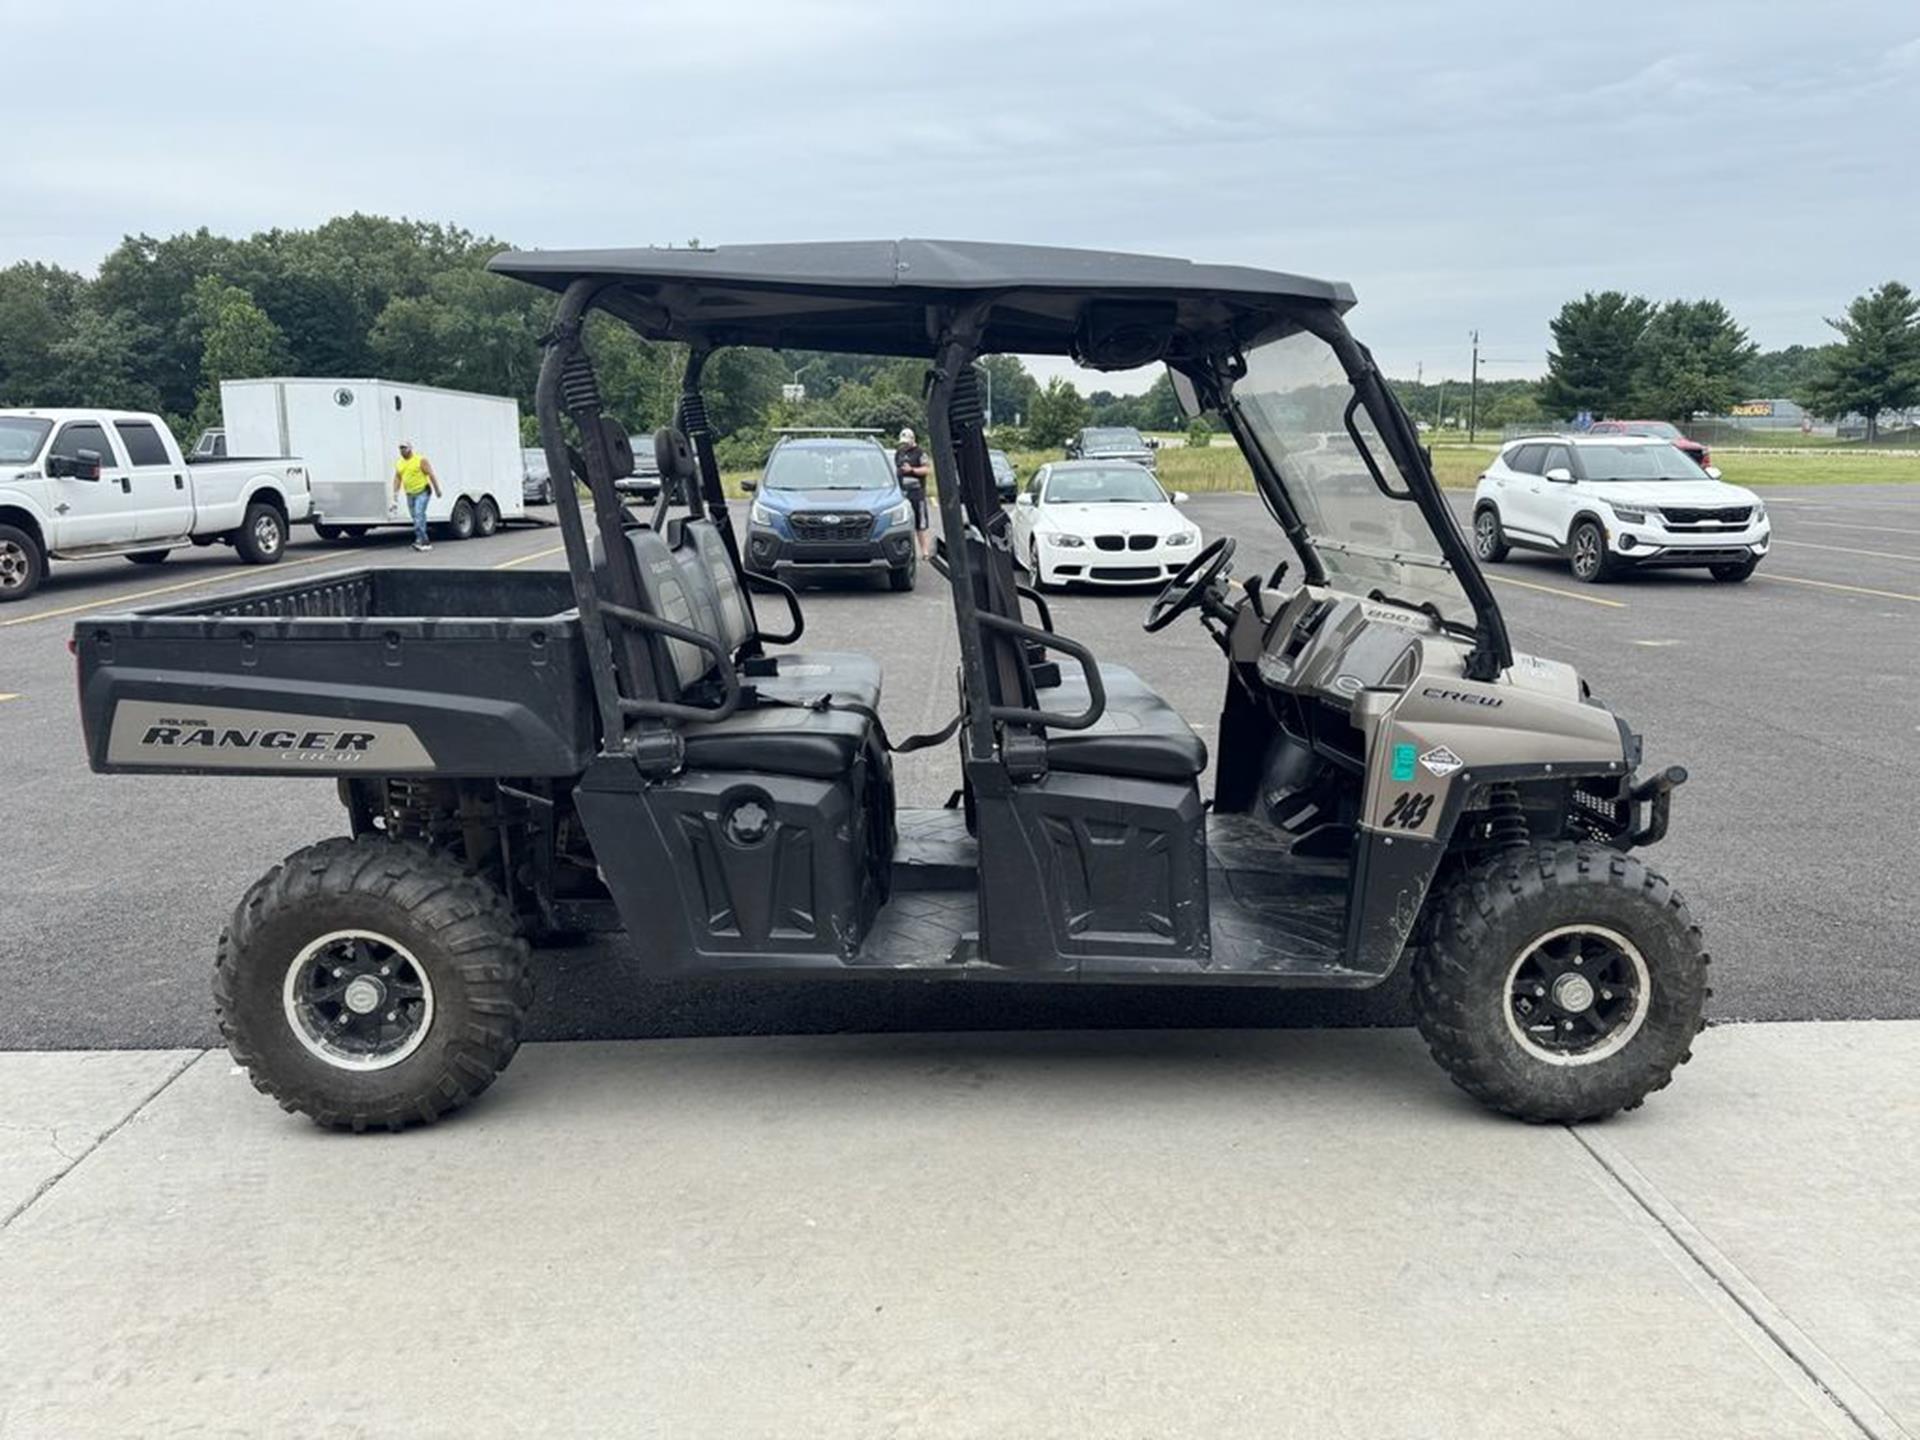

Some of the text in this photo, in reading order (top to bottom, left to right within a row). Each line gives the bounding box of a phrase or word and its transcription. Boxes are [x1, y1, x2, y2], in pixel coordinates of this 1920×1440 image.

[1422, 687, 1503, 708] CREW
[159, 718, 209, 727] POLARIS
[141, 727, 376, 751] RANGER
[1382, 791, 1436, 829] 243
